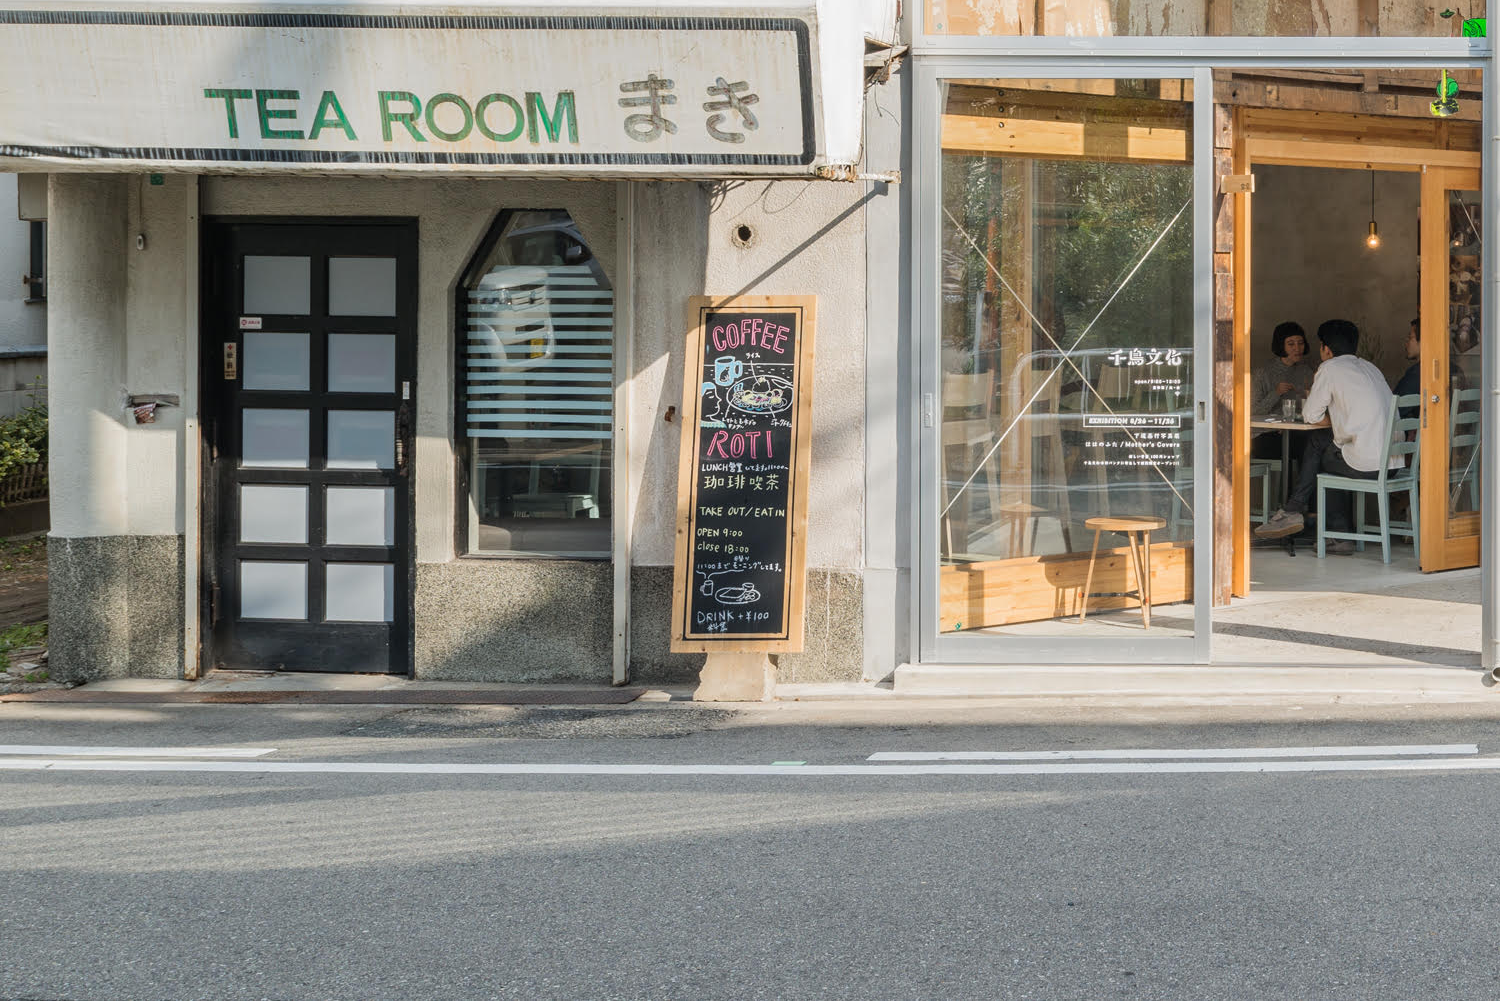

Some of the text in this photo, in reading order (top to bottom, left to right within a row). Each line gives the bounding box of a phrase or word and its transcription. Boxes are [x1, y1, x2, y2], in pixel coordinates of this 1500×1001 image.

[203, 88, 580, 144] TEA ROOM
[617, 73, 760, 144] まき
[712, 318, 791, 354] COFFEE
[1107, 347, 1183, 366] 千鳥文化
[1088, 417, 1128, 425] EXHIBITION
[706, 430, 774, 459] ROTI
[703, 473, 780, 491] 珈琲喫茶
[699, 506, 724, 517] TAKE
[696, 527, 743, 537] OPEN 9:00
[697, 540, 750, 555] close 18:00
[697, 610, 735, 624] DRINK
